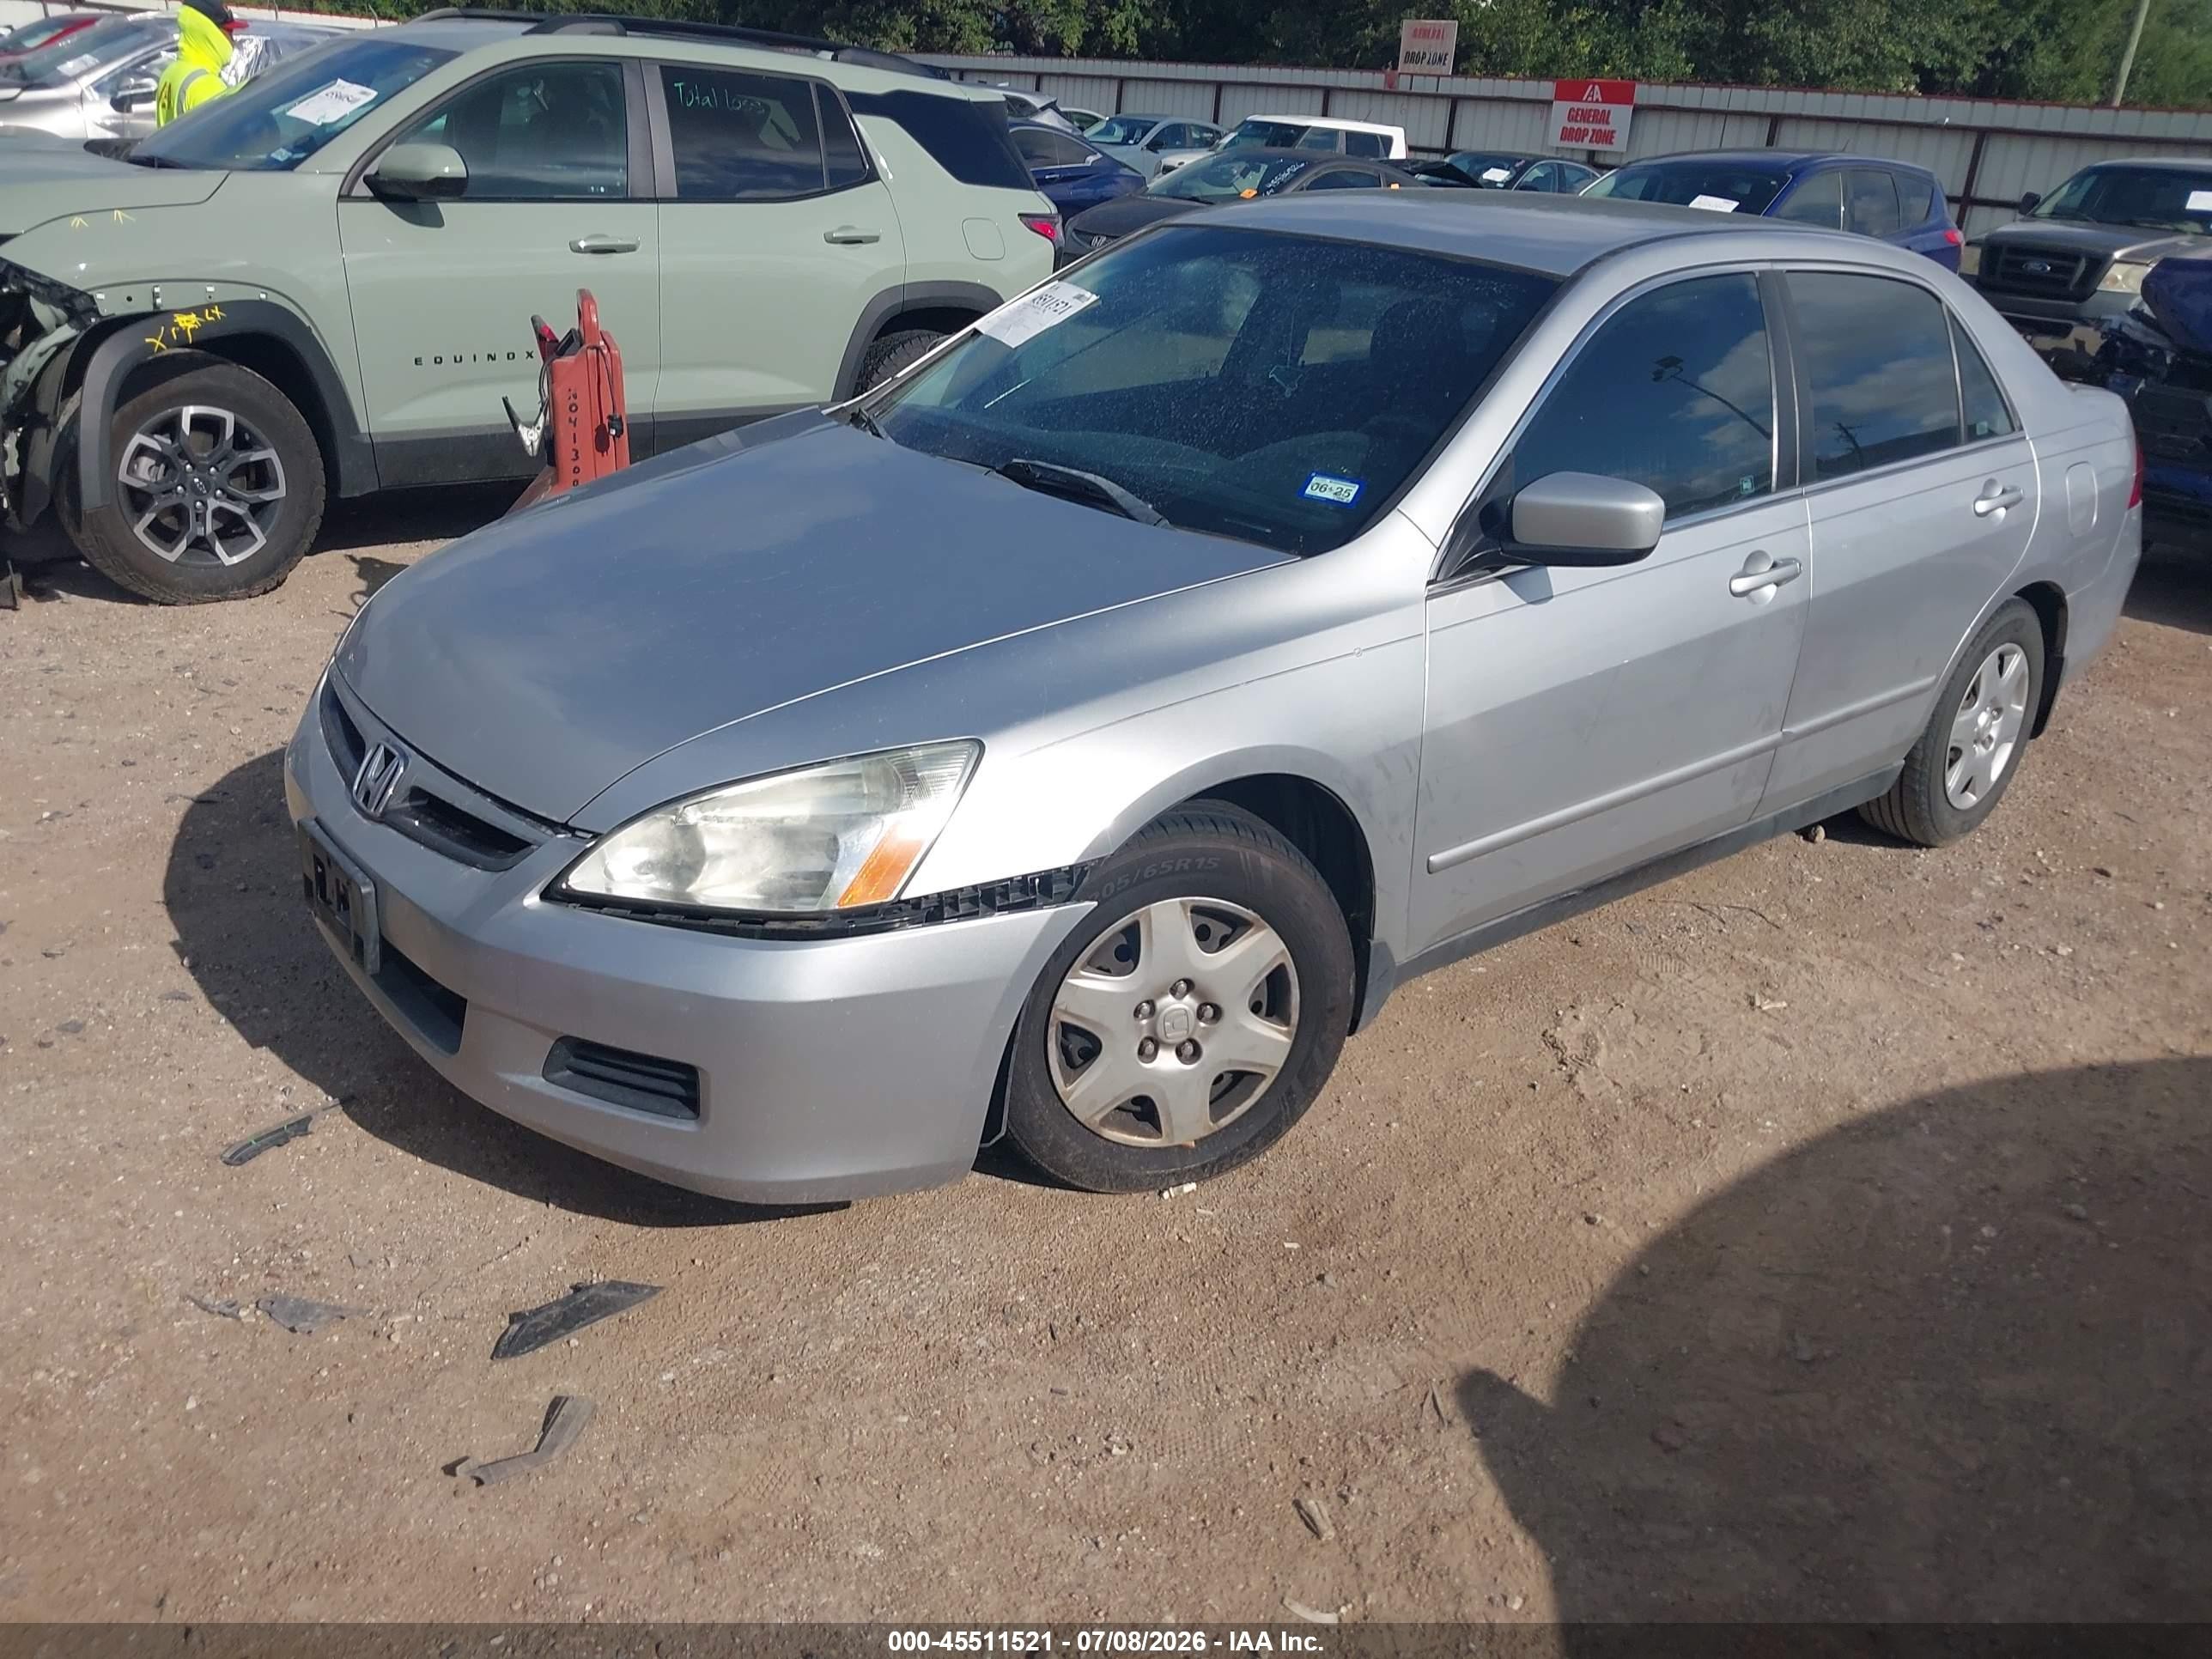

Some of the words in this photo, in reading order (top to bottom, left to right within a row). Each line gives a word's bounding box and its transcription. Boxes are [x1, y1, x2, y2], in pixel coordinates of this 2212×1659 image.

[1403, 51, 1426, 64] DROP
[1427, 52, 1449, 66] ZONE
[674, 82, 718, 109] Total
[1567, 106, 1611, 125] GENERAL
[1559, 126, 1589, 144] DROP
[1589, 129, 1616, 145] ZONE
[414, 350, 534, 366] EQUINOX
